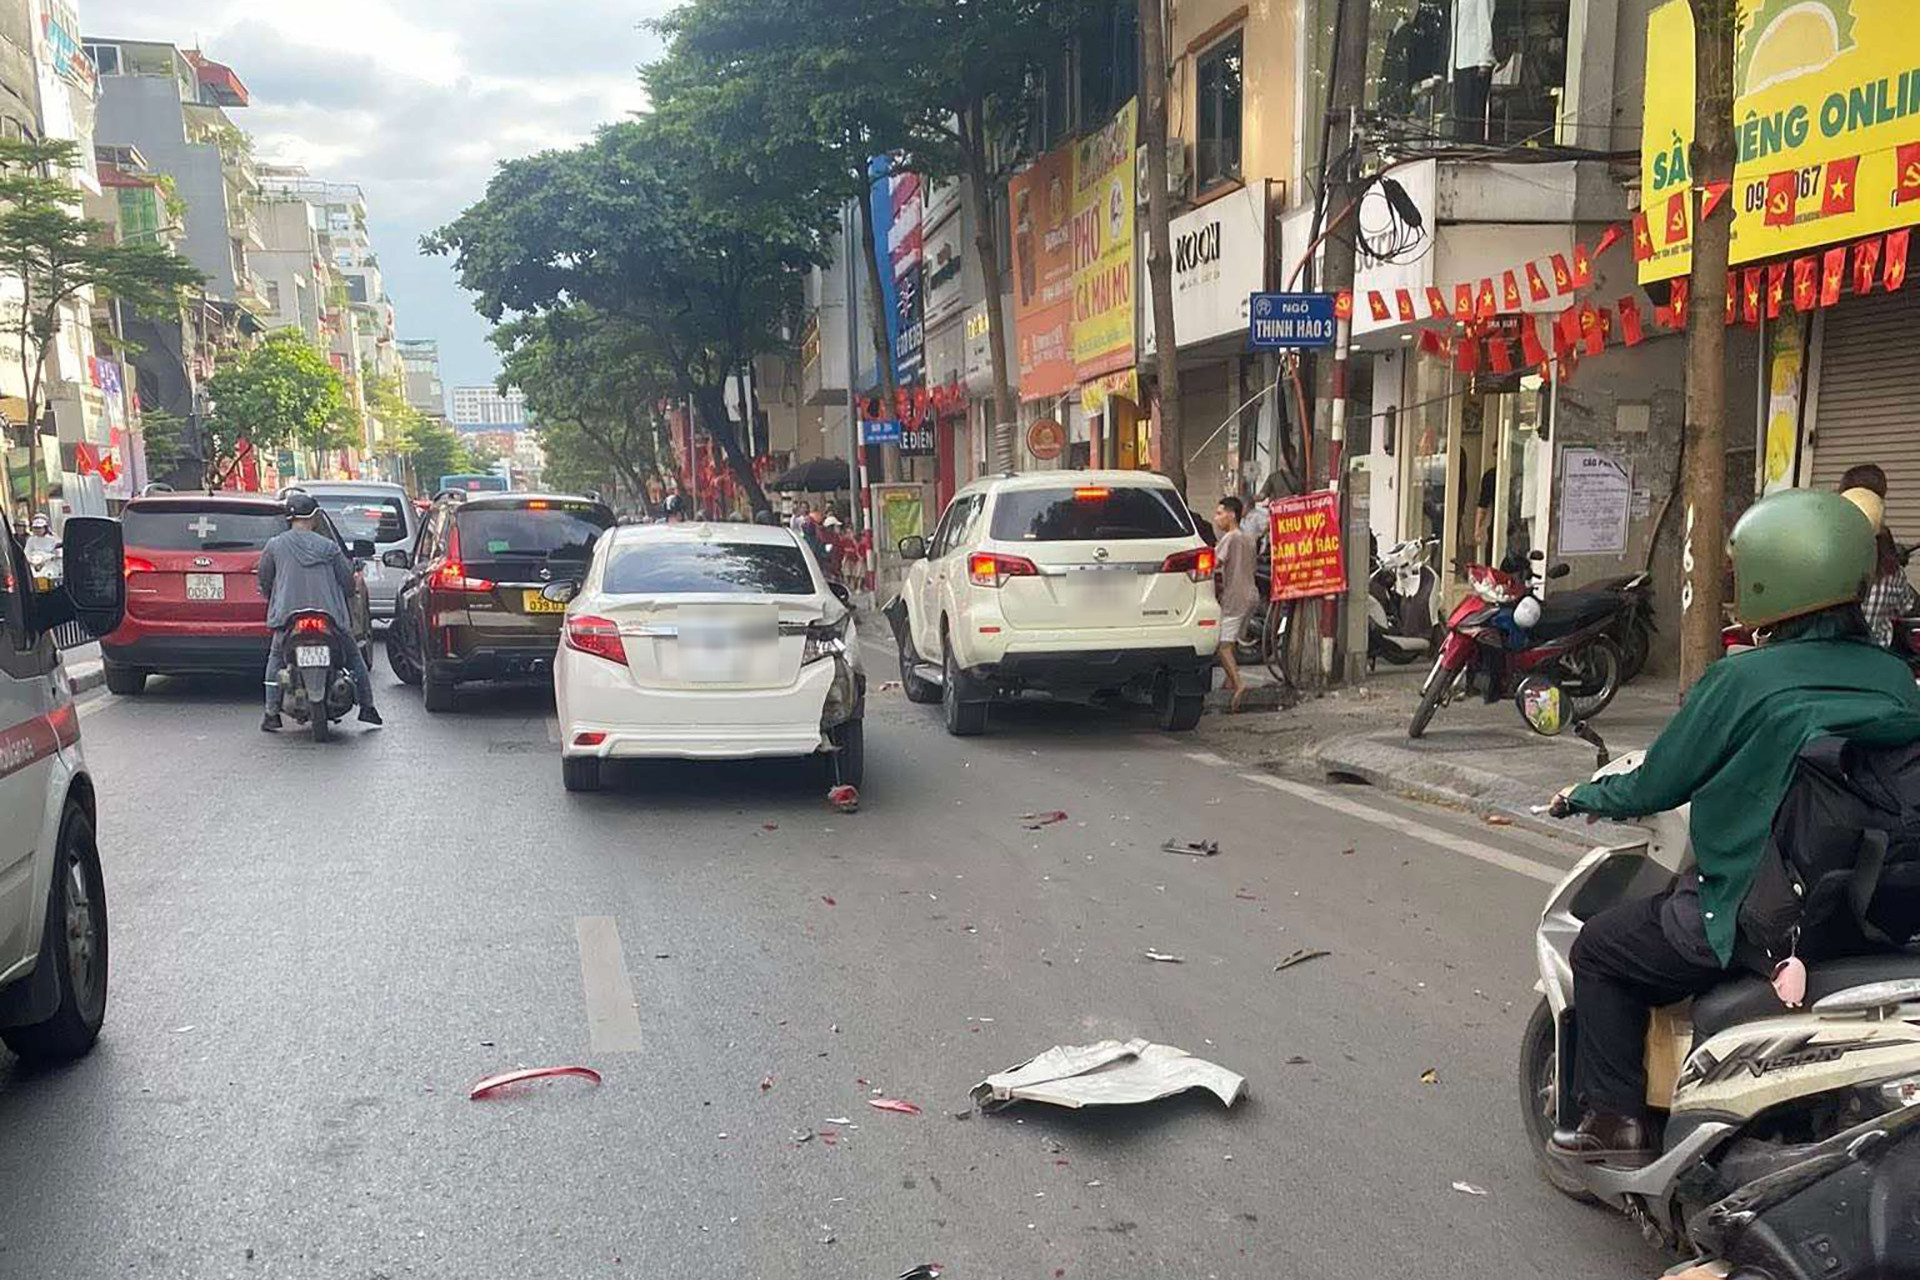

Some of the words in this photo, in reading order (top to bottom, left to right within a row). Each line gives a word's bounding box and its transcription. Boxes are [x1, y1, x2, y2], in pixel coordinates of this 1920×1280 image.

[1735, 105, 1809, 164] IÊNG
[1256, 319, 1293, 342] THỊNH
[1296, 315, 1322, 338] HÀO
[1324, 319, 1332, 338] 3
[1278, 516, 1302, 534] KHU
[1304, 511, 1326, 531] VỰC
[1316, 533, 1340, 553] RÁC
